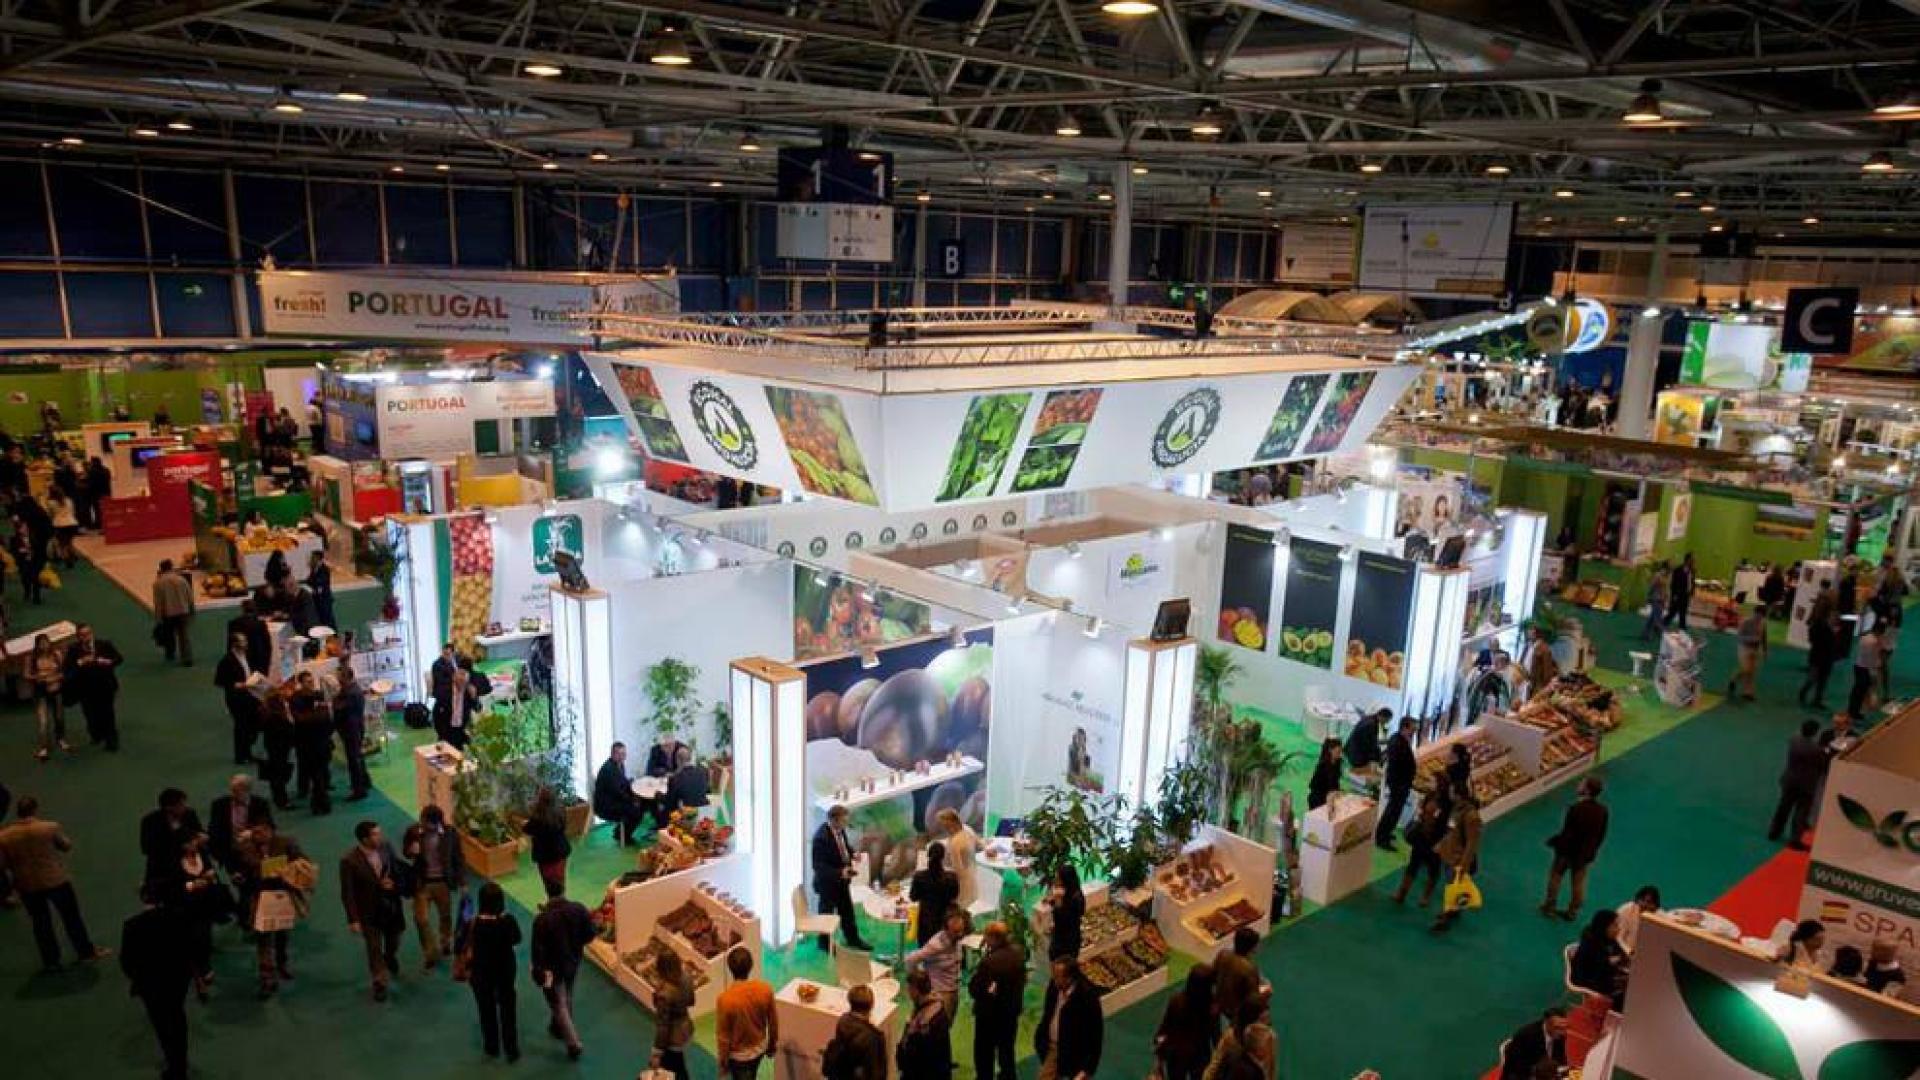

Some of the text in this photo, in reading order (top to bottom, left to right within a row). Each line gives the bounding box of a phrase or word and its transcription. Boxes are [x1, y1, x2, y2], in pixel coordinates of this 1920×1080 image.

[812, 159, 822, 194] 1
[872, 164, 885, 198] 1
[945, 245, 960, 274] B
[349, 291, 510, 318] PORTUGAL
[1801, 297, 1840, 343] C
[387, 396, 467, 412] PORTUGAL
